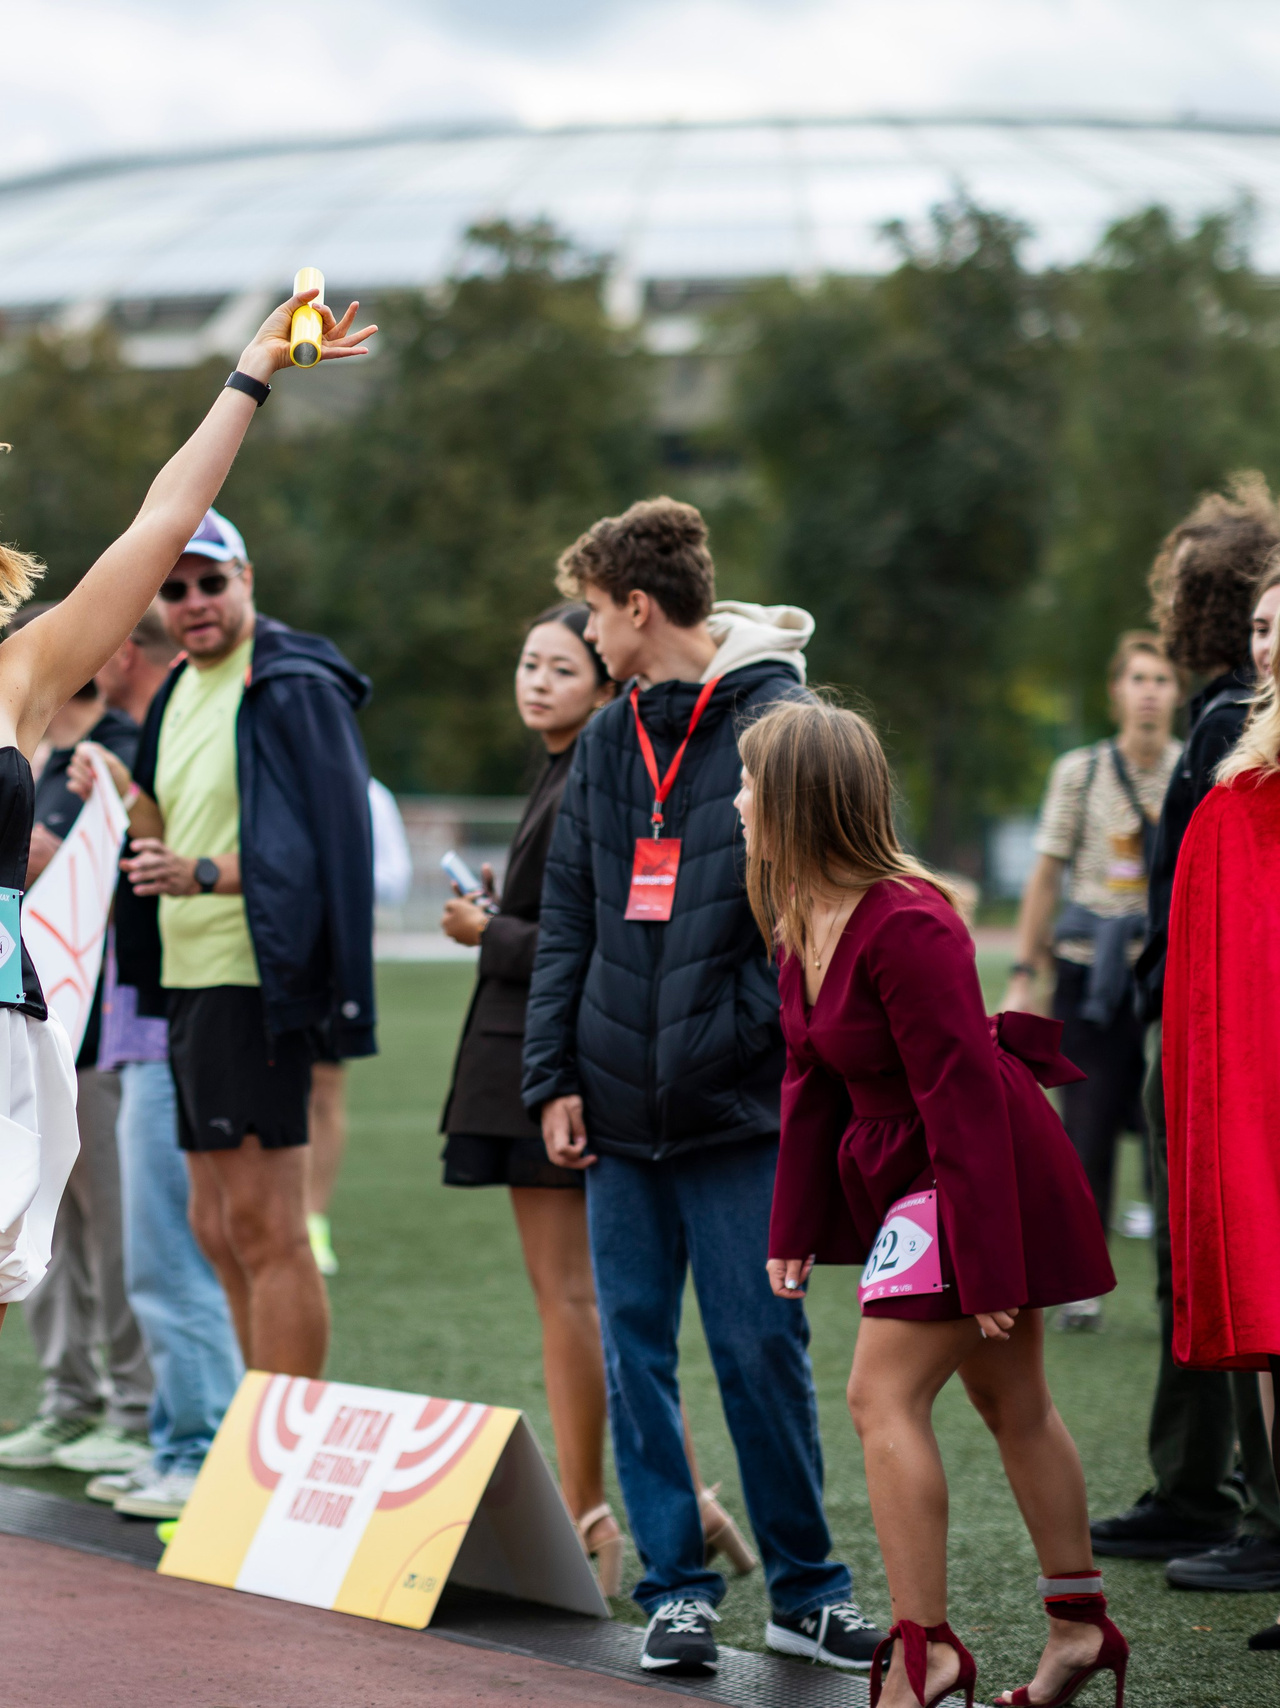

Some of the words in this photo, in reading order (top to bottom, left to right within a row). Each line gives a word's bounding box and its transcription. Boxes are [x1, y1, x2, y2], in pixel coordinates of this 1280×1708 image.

[909, 1240, 917, 1252] 2
[322, 1405, 395, 1454] БИТВА
[800, 1617, 818, 1634] N
